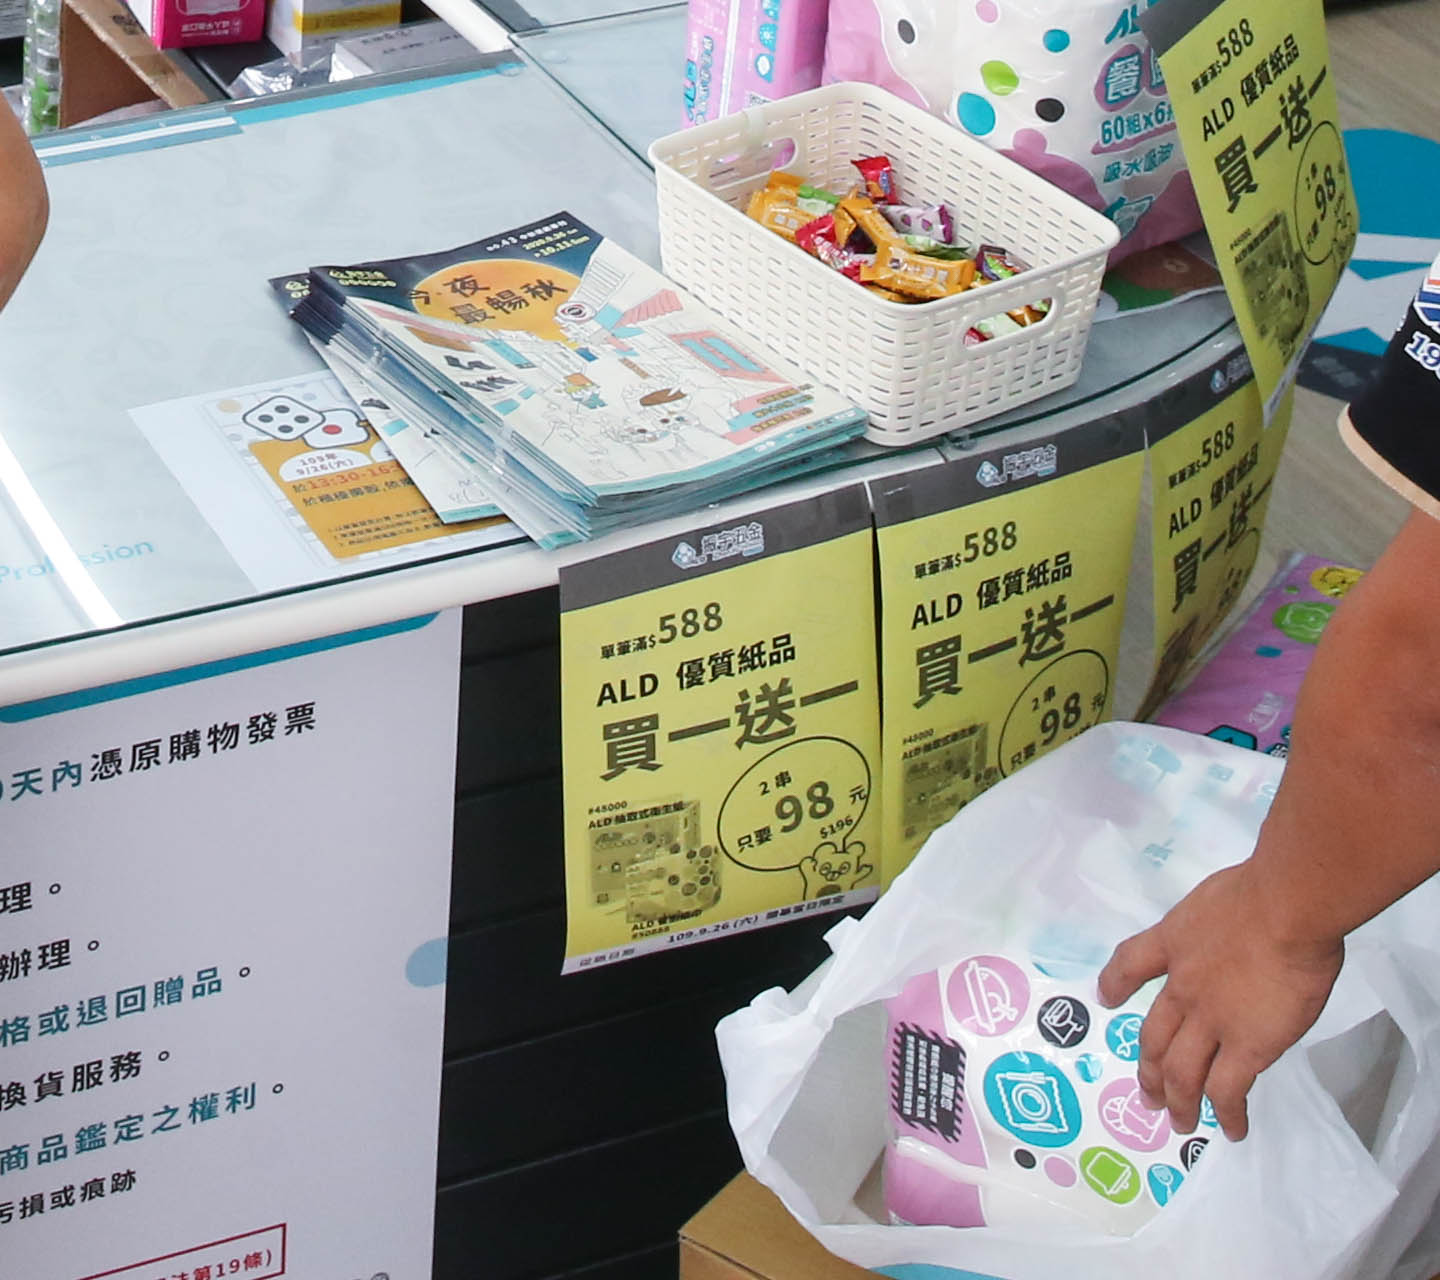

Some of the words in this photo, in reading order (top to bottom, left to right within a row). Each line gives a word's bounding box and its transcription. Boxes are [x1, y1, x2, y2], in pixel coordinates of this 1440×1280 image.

[1201, 103, 1236, 142] ALD
[1239, 32, 1301, 109] 優質紙品
[1214, 66, 1328, 214] 買一送一
[700, 524, 765, 555] 振宇五金
[1168, 496, 1203, 539] ALD
[1172, 472, 1274, 614] 買一送一
[911, 592, 964, 630] ALD
[976, 551, 1073, 610] 優質紙品
[596, 671, 660, 708] ALD
[676, 633, 797, 691] 優質紙品
[912, 593, 1116, 710] 買一送一
[599, 678, 860, 782] 買一送一
[1040, 691, 1082, 746] 98
[588, 816, 613, 830] ALD
[737, 828, 773, 854] 只要
[774, 780, 836, 834] 98
[849, 784, 868, 804] 元
